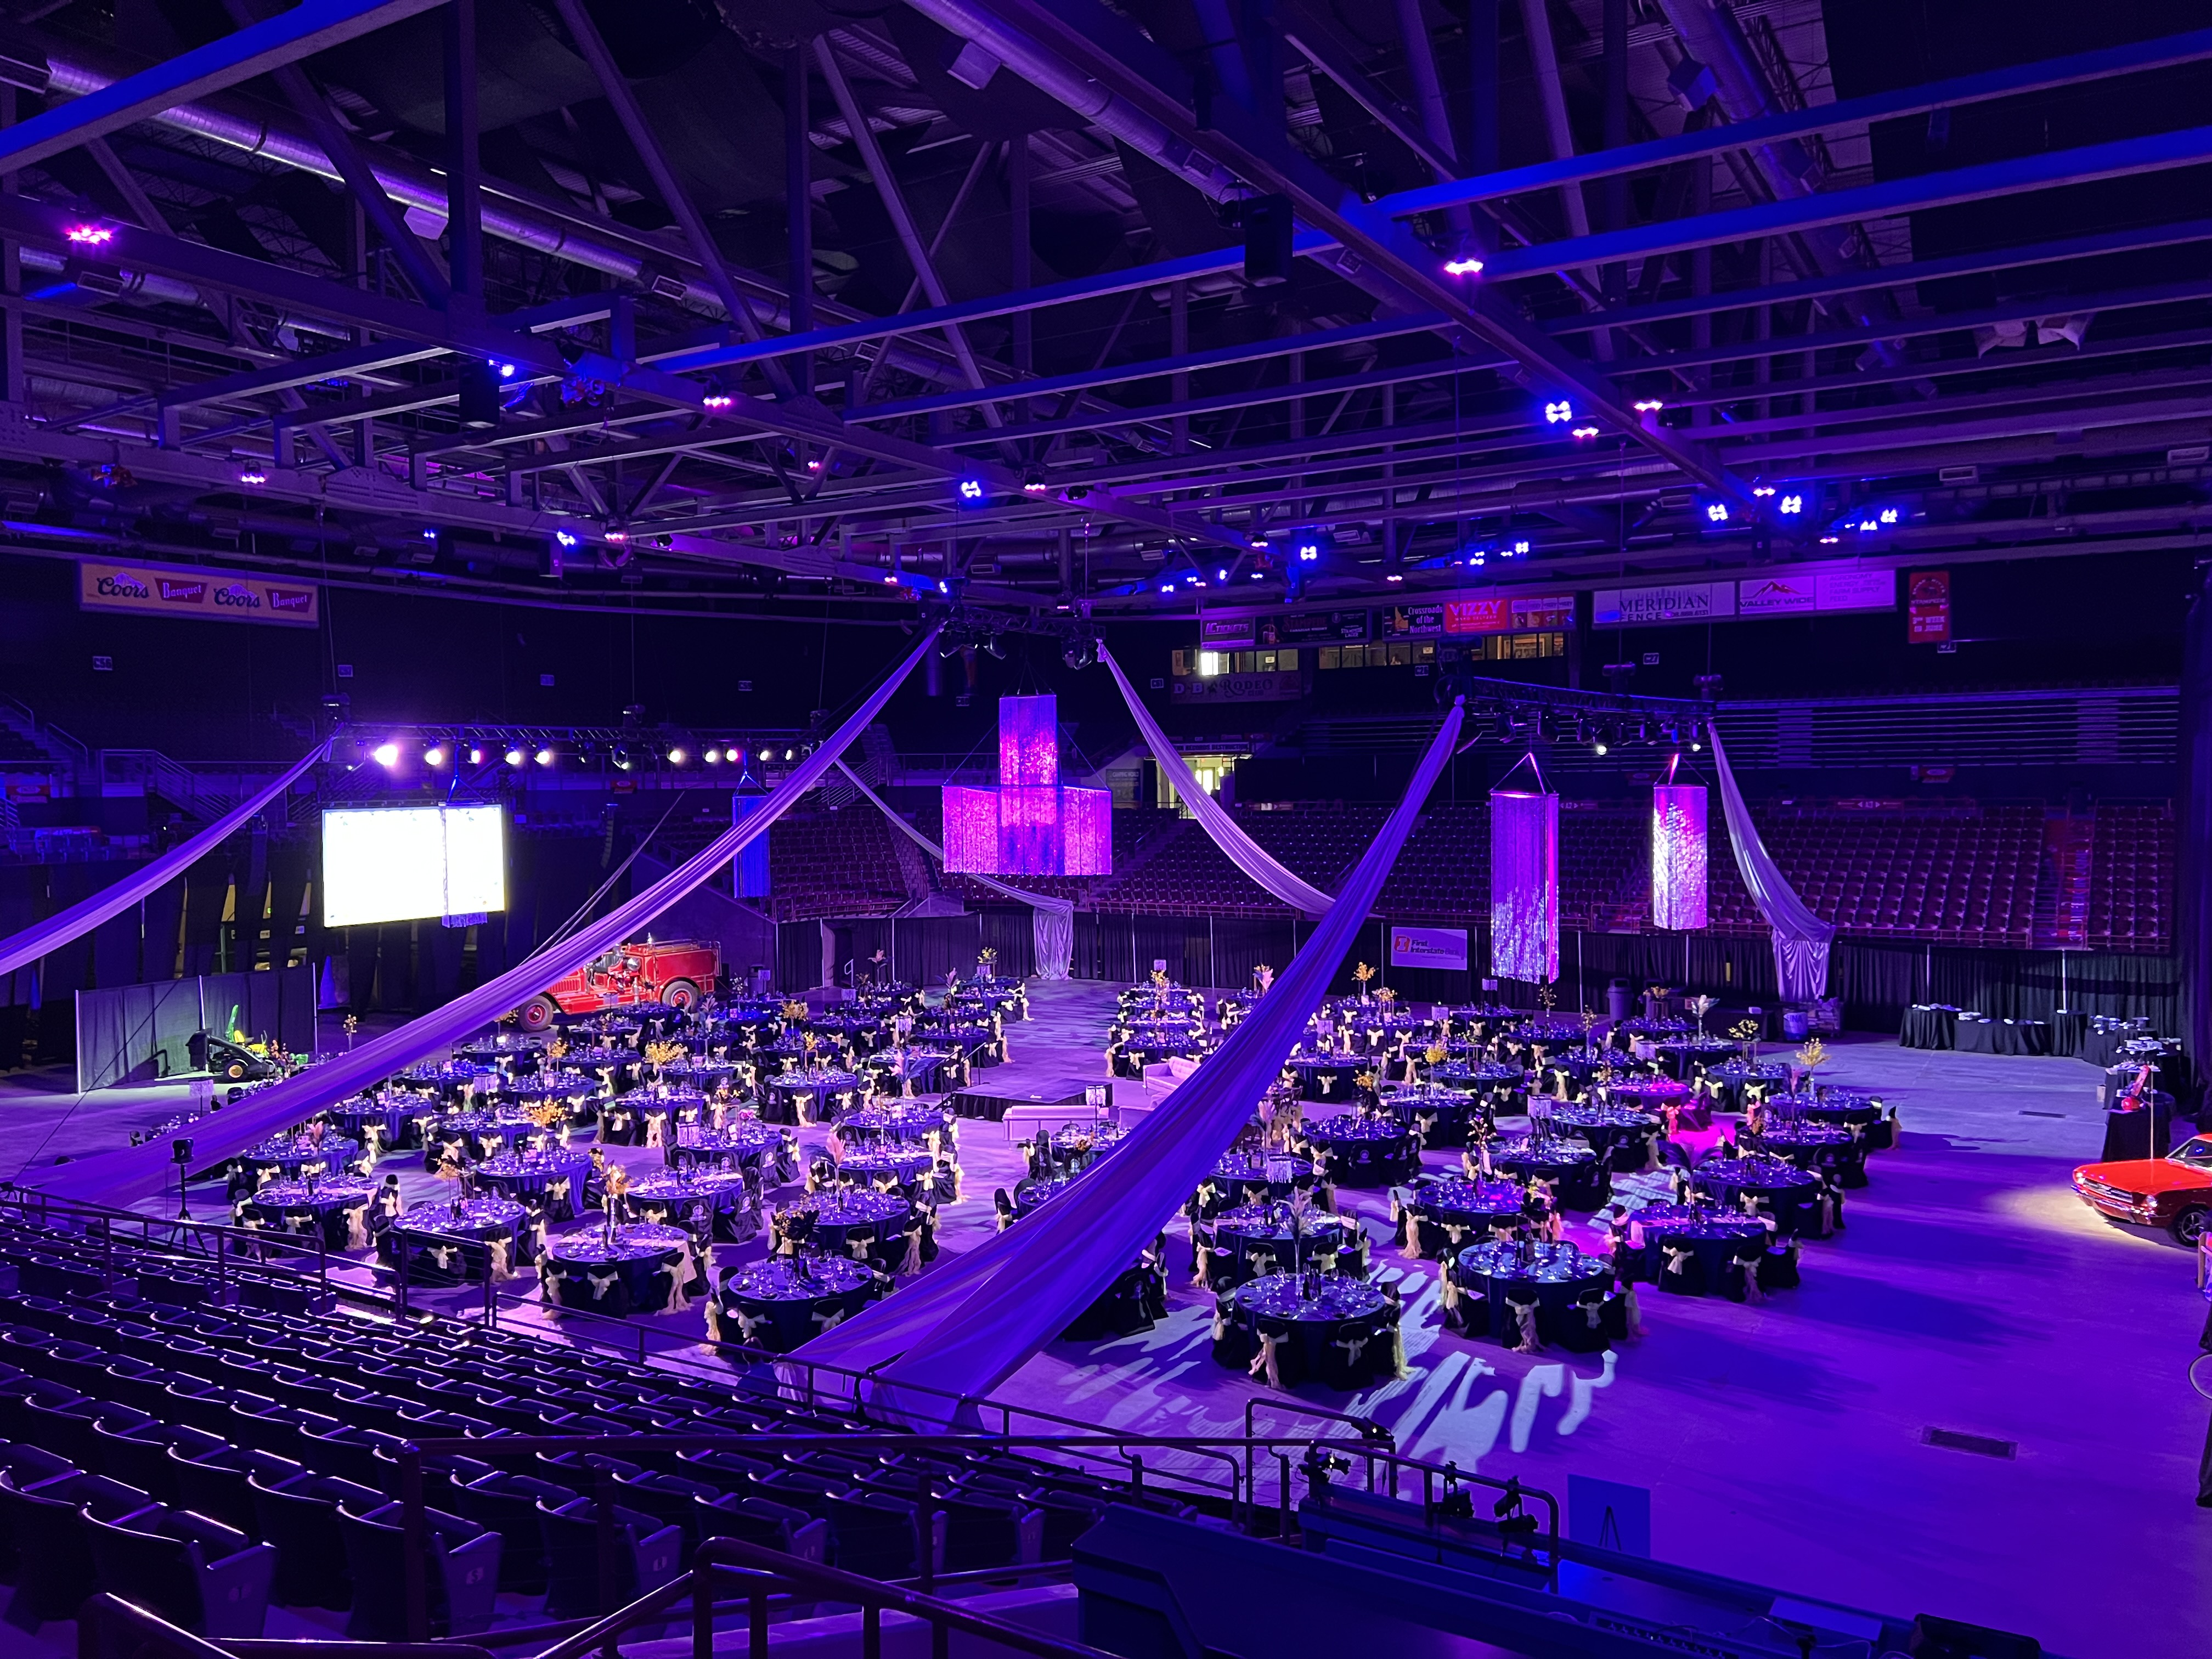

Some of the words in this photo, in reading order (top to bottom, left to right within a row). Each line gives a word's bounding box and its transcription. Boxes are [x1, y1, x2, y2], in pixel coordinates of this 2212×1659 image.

[97, 577, 149, 599] Coors
[163, 582, 201, 599] Banquet
[213, 588, 261, 608] Coors
[273, 593, 307, 608] Banquet
[1620, 594, 1709, 613] MERIDIAN
[1740, 598, 1782, 607] VALLEY
[1784, 596, 1814, 605] WIDE
[1408, 605, 1443, 616] Crossroads
[1449, 600, 1503, 616] VIZZY
[1417, 616, 1423, 624] of
[1424, 616, 1434, 624] the
[1620, 612, 1662, 622] FENCE
[1409, 624, 1441, 634] Northwest
[94, 658, 111, 668] C56
[1220, 678, 1273, 698] RODEO
[1410, 946, 1444, 954] Interstate
[1445, 947, 1460, 956] Bank
